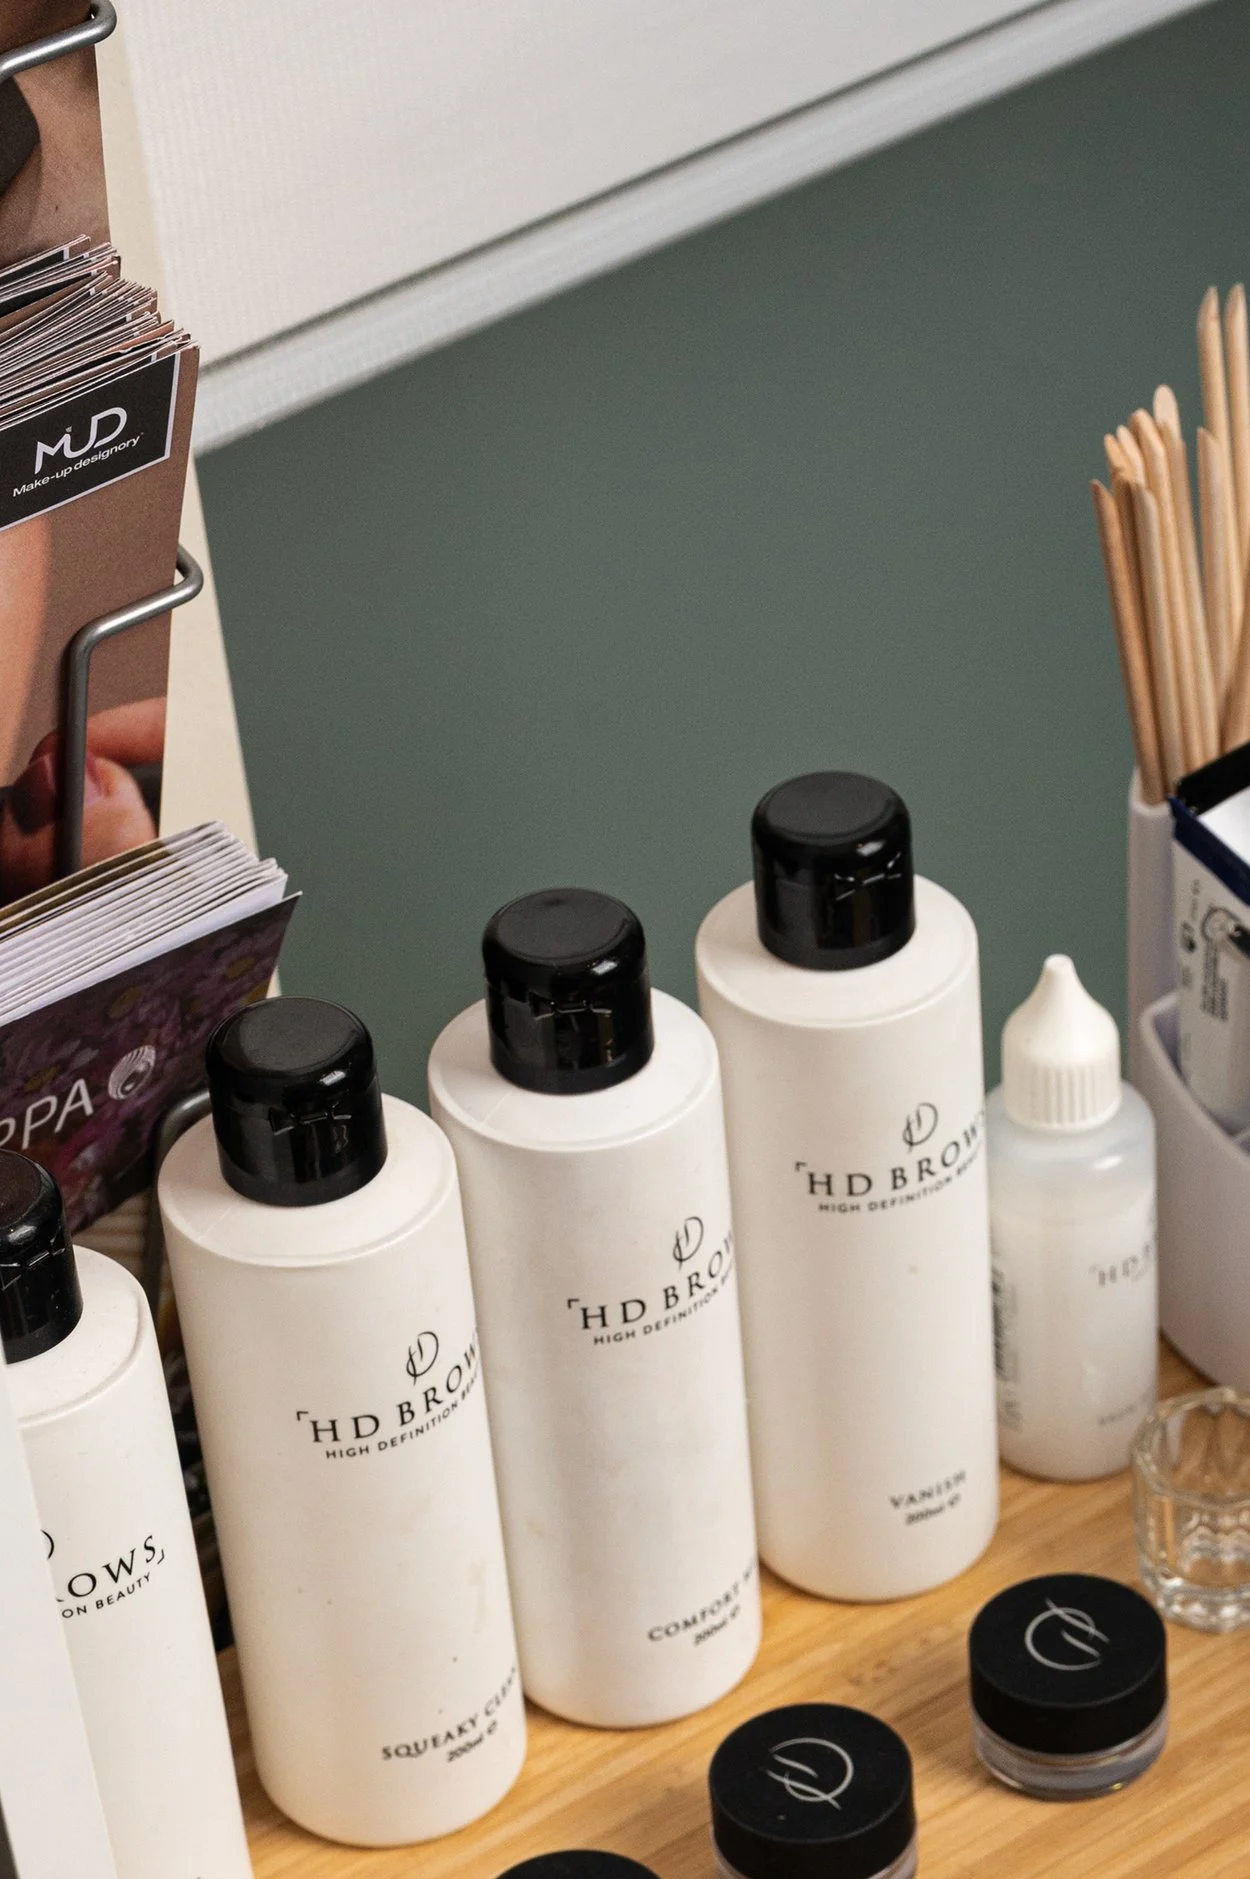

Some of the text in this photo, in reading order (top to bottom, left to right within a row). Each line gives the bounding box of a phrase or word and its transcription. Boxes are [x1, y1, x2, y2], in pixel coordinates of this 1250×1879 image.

[12, 435, 142, 498] Make-up designory
[34, 406, 128, 475] MUD
[807, 1171, 873, 1197] HD
[817, 1175, 954, 1213] HIGH DEFINITION
[580, 1298, 647, 1330] HD
[593, 1287, 718, 1346] HIGH DEFINITION
[309, 1334, 477, 1444] HD BROW
[325, 1444, 371, 1460] HIGH
[376, 1399, 459, 1452] DEFINITION
[887, 1468, 967, 1511] VANISH
[56, 1534, 155, 1603] OWS
[95, 1571, 151, 1610] BEAUTY
[381, 1712, 479, 1762] SQUEAKY
